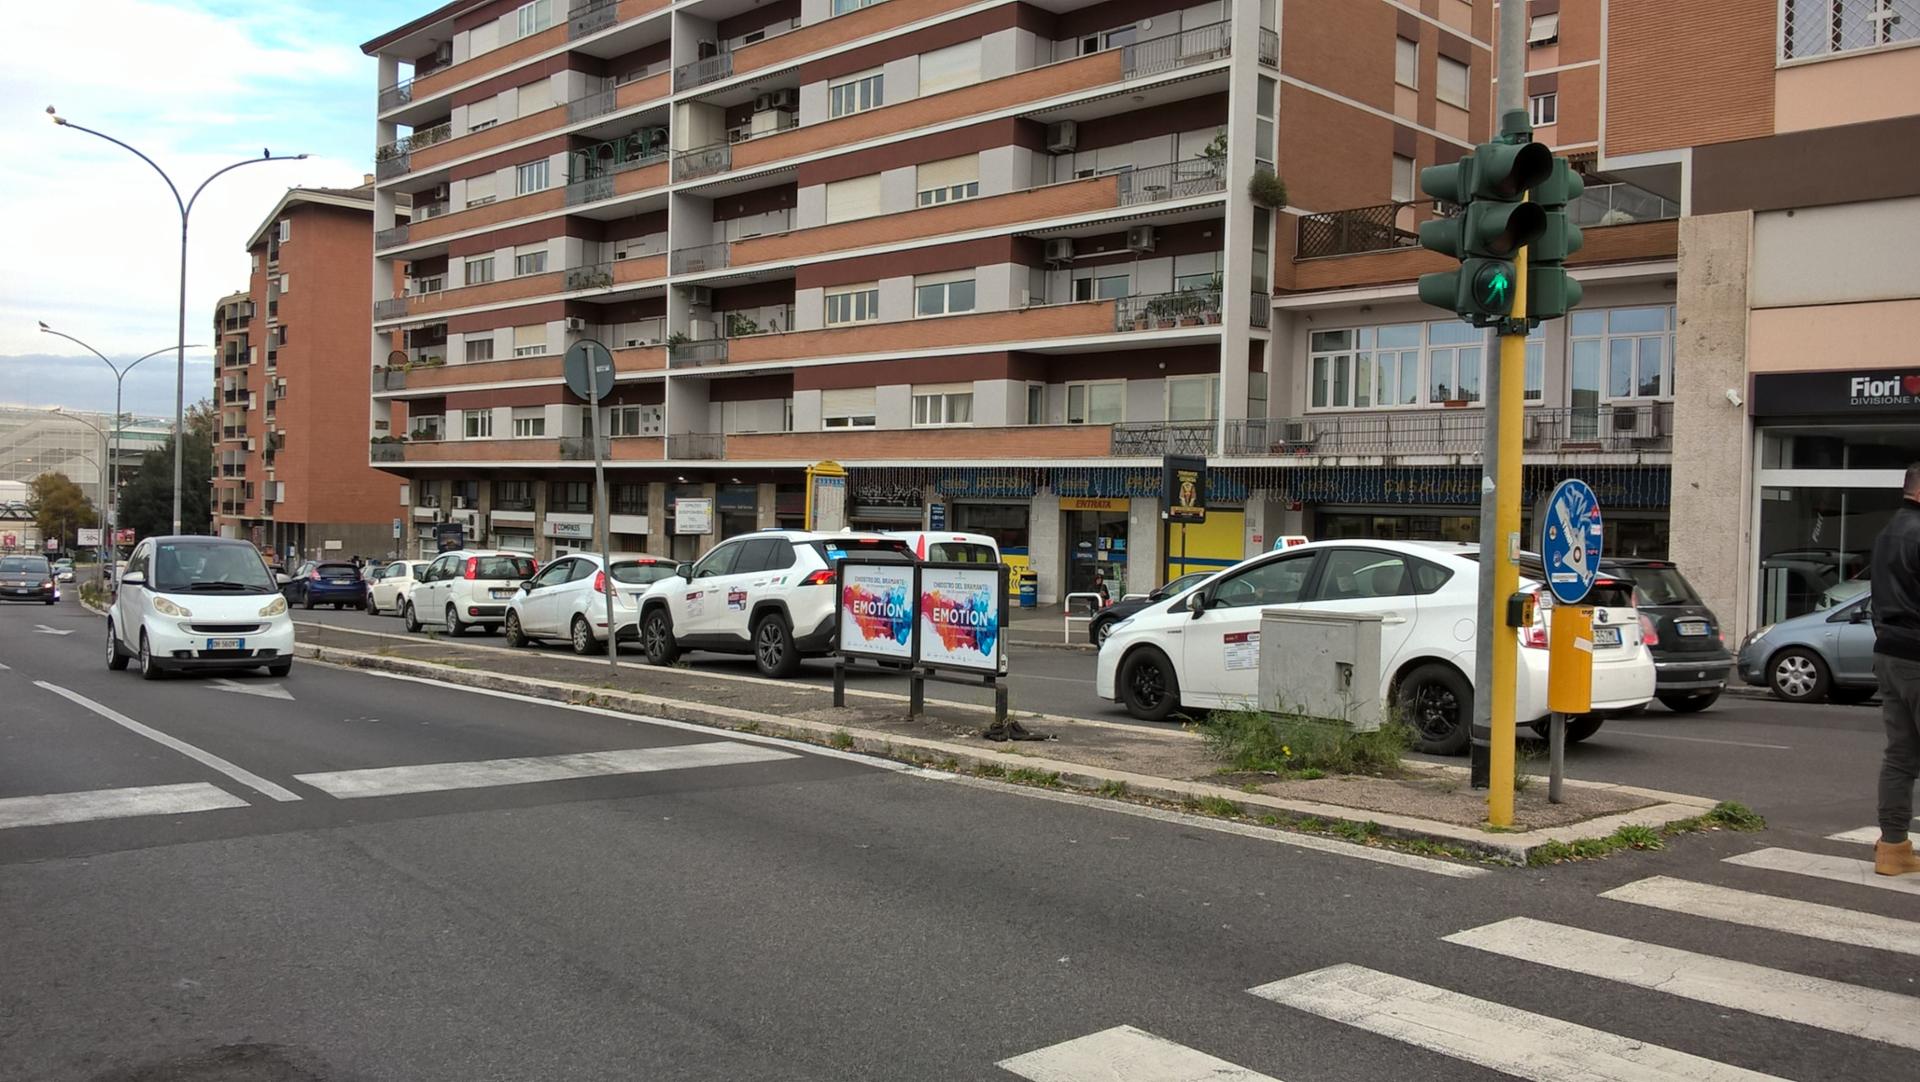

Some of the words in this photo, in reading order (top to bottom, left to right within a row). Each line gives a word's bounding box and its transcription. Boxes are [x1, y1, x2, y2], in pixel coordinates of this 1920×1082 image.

[1851, 375, 1900, 397] Fiori
[1851, 396, 1911, 405] DIVISIONE
[1076, 500, 1111, 509] ENTRATA
[558, 523, 580, 531] COMPASS
[853, 600, 904, 617] EMOTION
[933, 608, 988, 626] EMOTION
